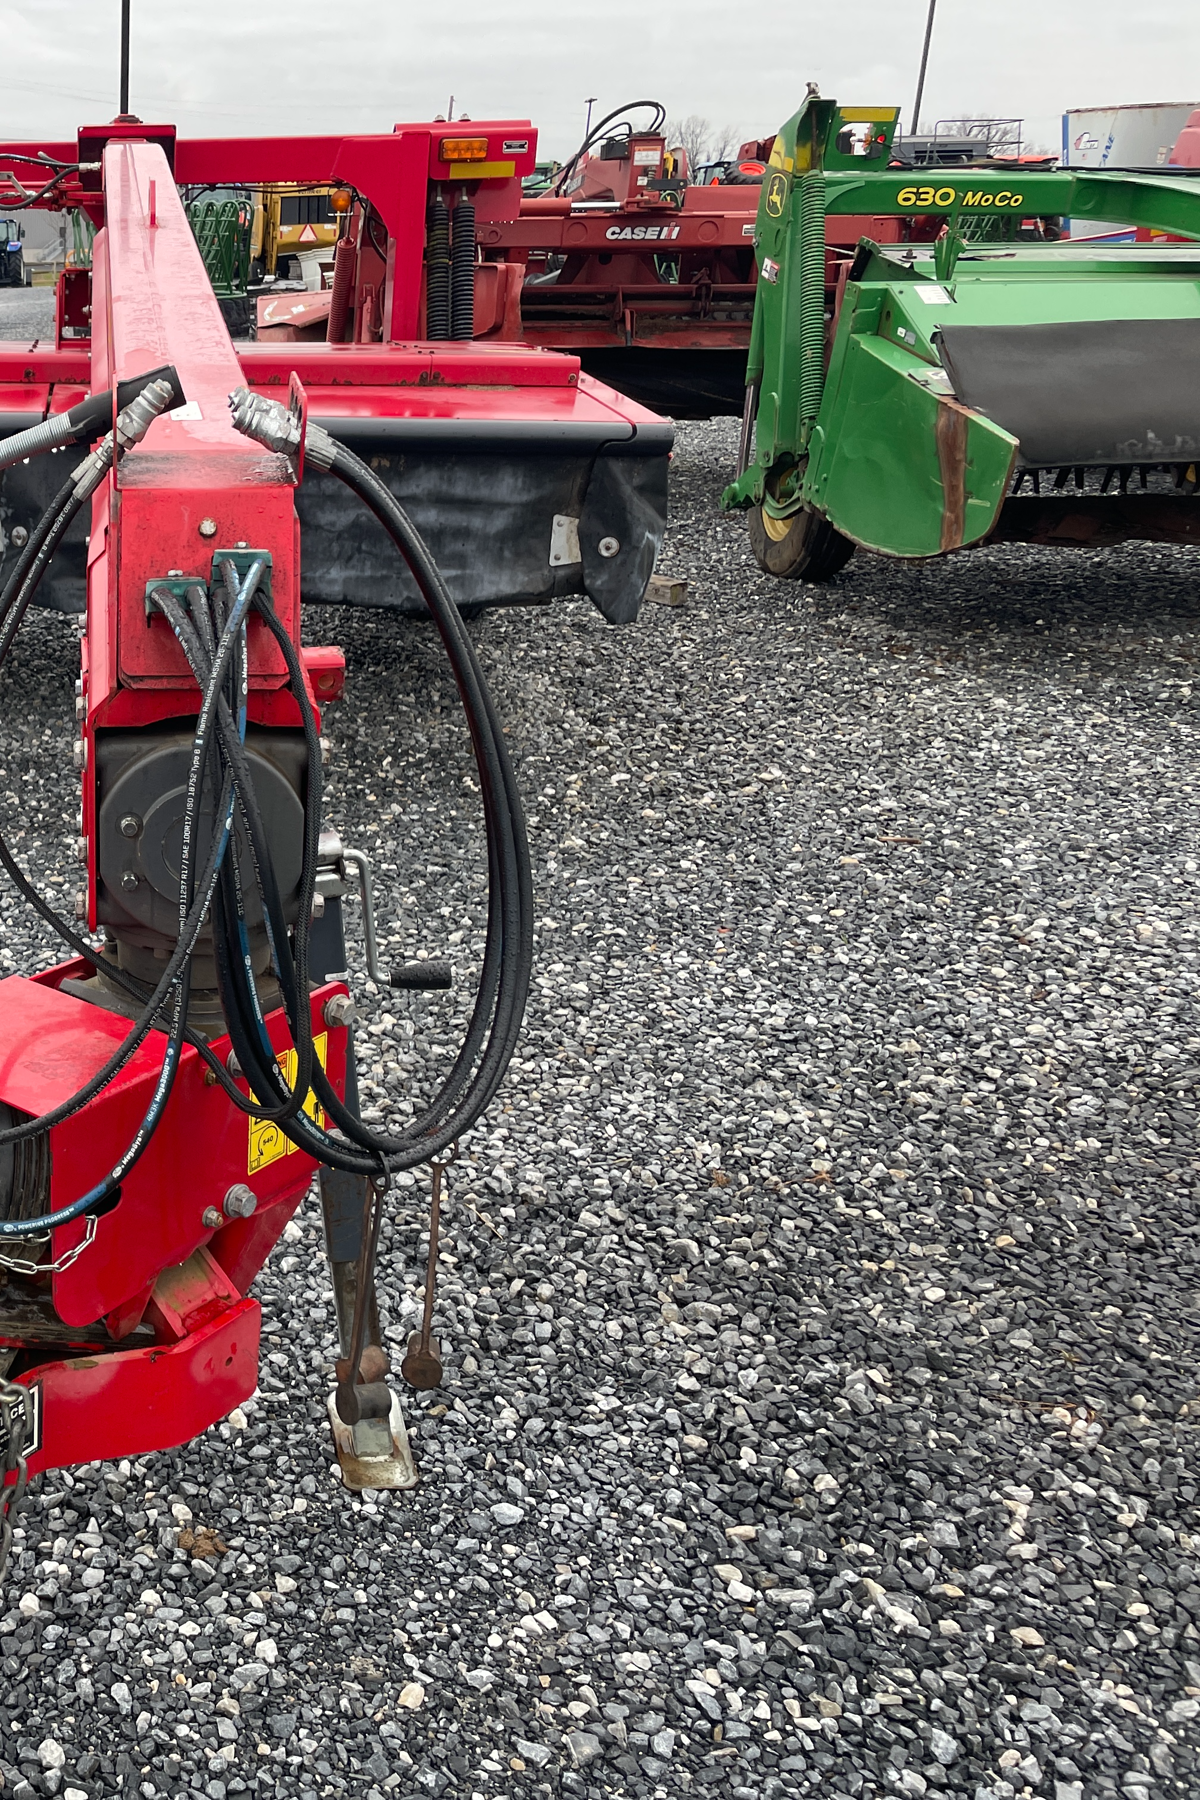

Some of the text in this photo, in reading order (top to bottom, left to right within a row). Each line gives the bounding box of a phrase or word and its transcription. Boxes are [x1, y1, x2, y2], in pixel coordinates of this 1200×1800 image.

[896, 186, 1024, 207] 630 MoCo
[605, 226, 660, 240] CASE
[7, 606, 18, 624] MSHA
[210, 658, 223, 679] MSHA
[202, 679, 217, 713] Resistant
[197, 713, 209, 736] Flame
[190, 753, 201, 772] Type
[186, 797, 194, 811] ISO
[183, 815, 193, 844] 100R17
[182, 845, 190, 859] SAE
[181, 864, 189, 880] R17
[180, 880, 188, 903] 11237
[179, 904, 187, 918] ISO
[172, 1006, 182, 1022] MPa
[170, 1023, 179, 1039] 22.5
[262, 1135, 274, 1146] 540
